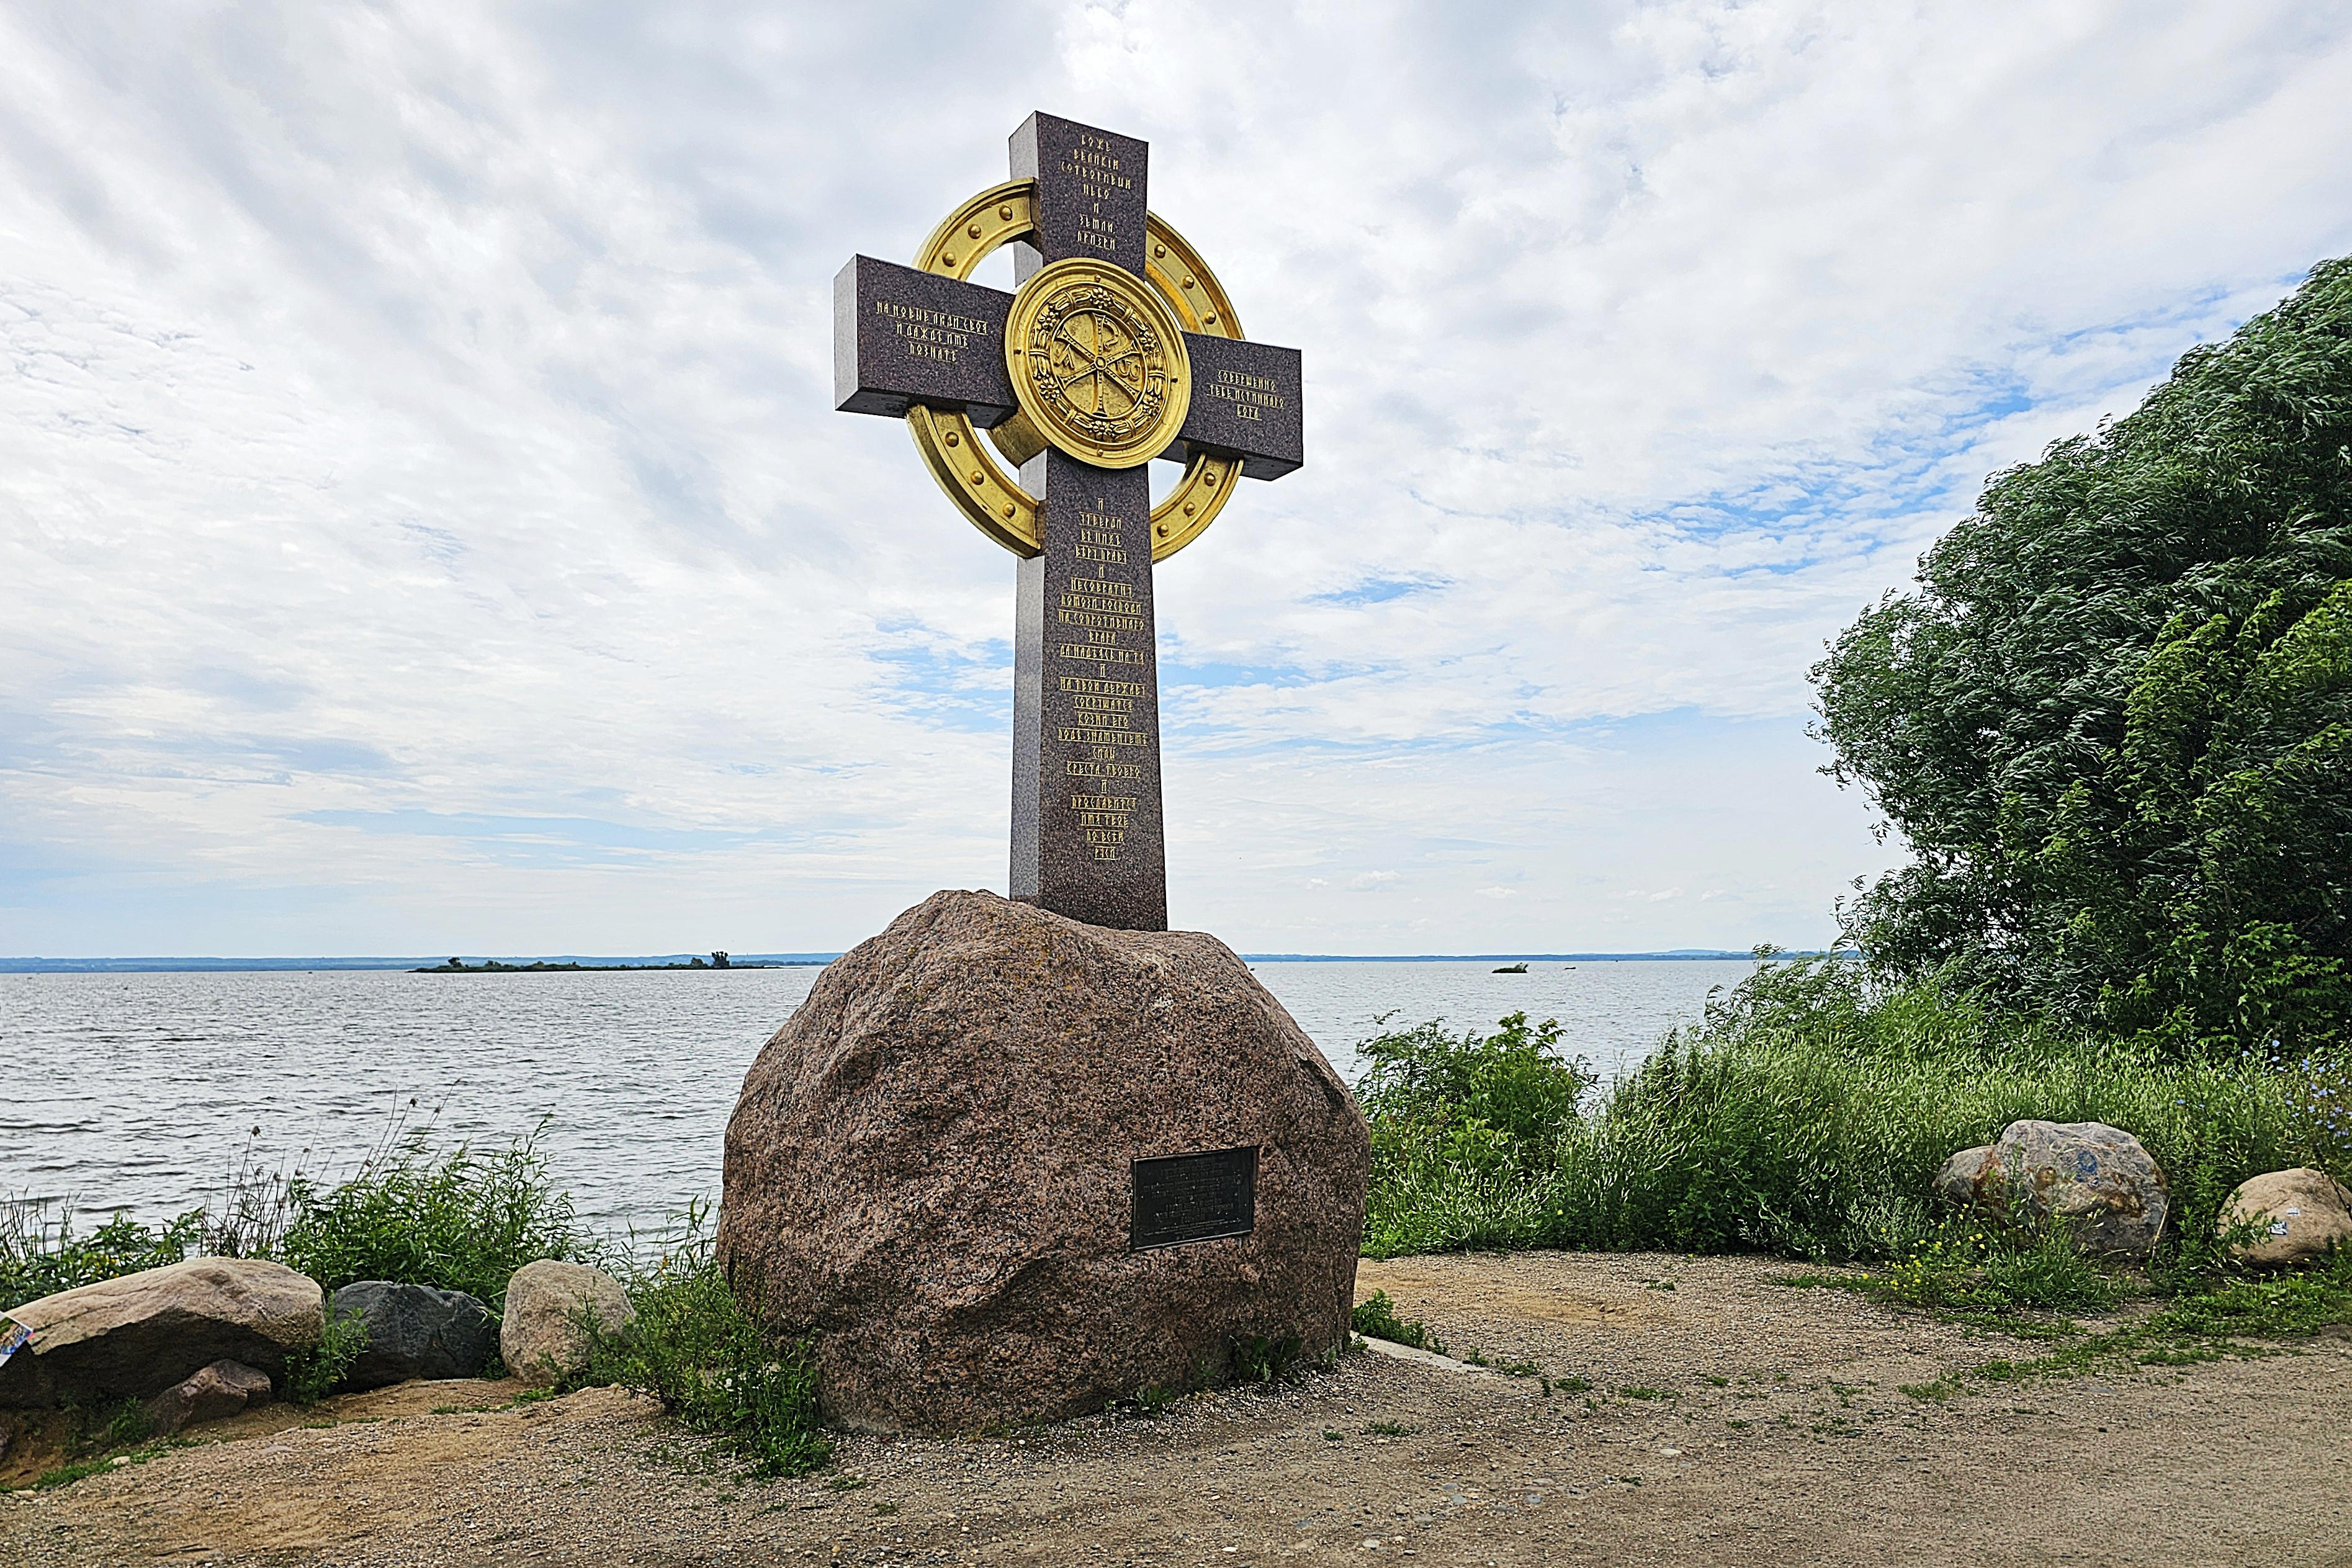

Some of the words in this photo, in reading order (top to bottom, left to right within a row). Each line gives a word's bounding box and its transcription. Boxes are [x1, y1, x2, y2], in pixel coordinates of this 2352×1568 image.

[1082, 134, 1111, 152] БОЖЕ
[1083, 183, 1110, 200] НЕБО
[1093, 202, 1099, 214] И
[1077, 230, 1115, 251] ПРИЗРИ
[877, 301, 888, 314] НА
[893, 305, 928, 322] НОВЫЕ
[963, 318, 987, 334] СВОЯ
[897, 322, 902, 334] И
[1218, 370, 1277, 391] СОВЕРШЕННО
[1210, 384, 1232, 398] ТЕБЕ
[1235, 388, 1284, 408] ИСТИННАГО
[1237, 405, 1259, 419] БОГА
[1098, 499, 1103, 511] И
[1080, 514, 1121, 529] УТВЕРДИ
[1081, 529, 1091, 542] ВЪ
[1101, 549, 1126, 563] ПРАВУ
[1098, 565, 1104, 578] И
[1061, 594, 1097, 609] ПОМОЗИ
[1102, 599, 1141, 614] ГОСПОДИ
[1059, 610, 1069, 623] НА
[1074, 612, 1144, 631] СОПРОТИВНАГО
[1060, 644, 1070, 656] ДА
[1118, 650, 1129, 662] НА
[1133, 652, 1144, 665] ТЯ
[1100, 665, 1105, 677] И
[1060, 678, 1071, 690] НА
[1104, 681, 1145, 696] ДЕРЖАВУ
[1074, 696, 1133, 711] СОКРУШАТСЯ
[1078, 712, 1107, 726] КОЗНИ
[1112, 715, 1128, 727] ЕГО
[1092, 746, 1115, 759] СИЛЫ
[1067, 761, 1100, 775] КРЕСТА
[1106, 764, 1140, 778] ТВОЕГО
[1101, 780, 1106, 793] И
[1072, 796, 1136, 810] ПРОСЛАВИТСЯ
[1081, 813, 1100, 825] ИМЯ
[1105, 814, 1128, 827] ТВОЕ
[1087, 830, 1097, 842] ПО
[1094, 847, 1116, 858] РУСИ
